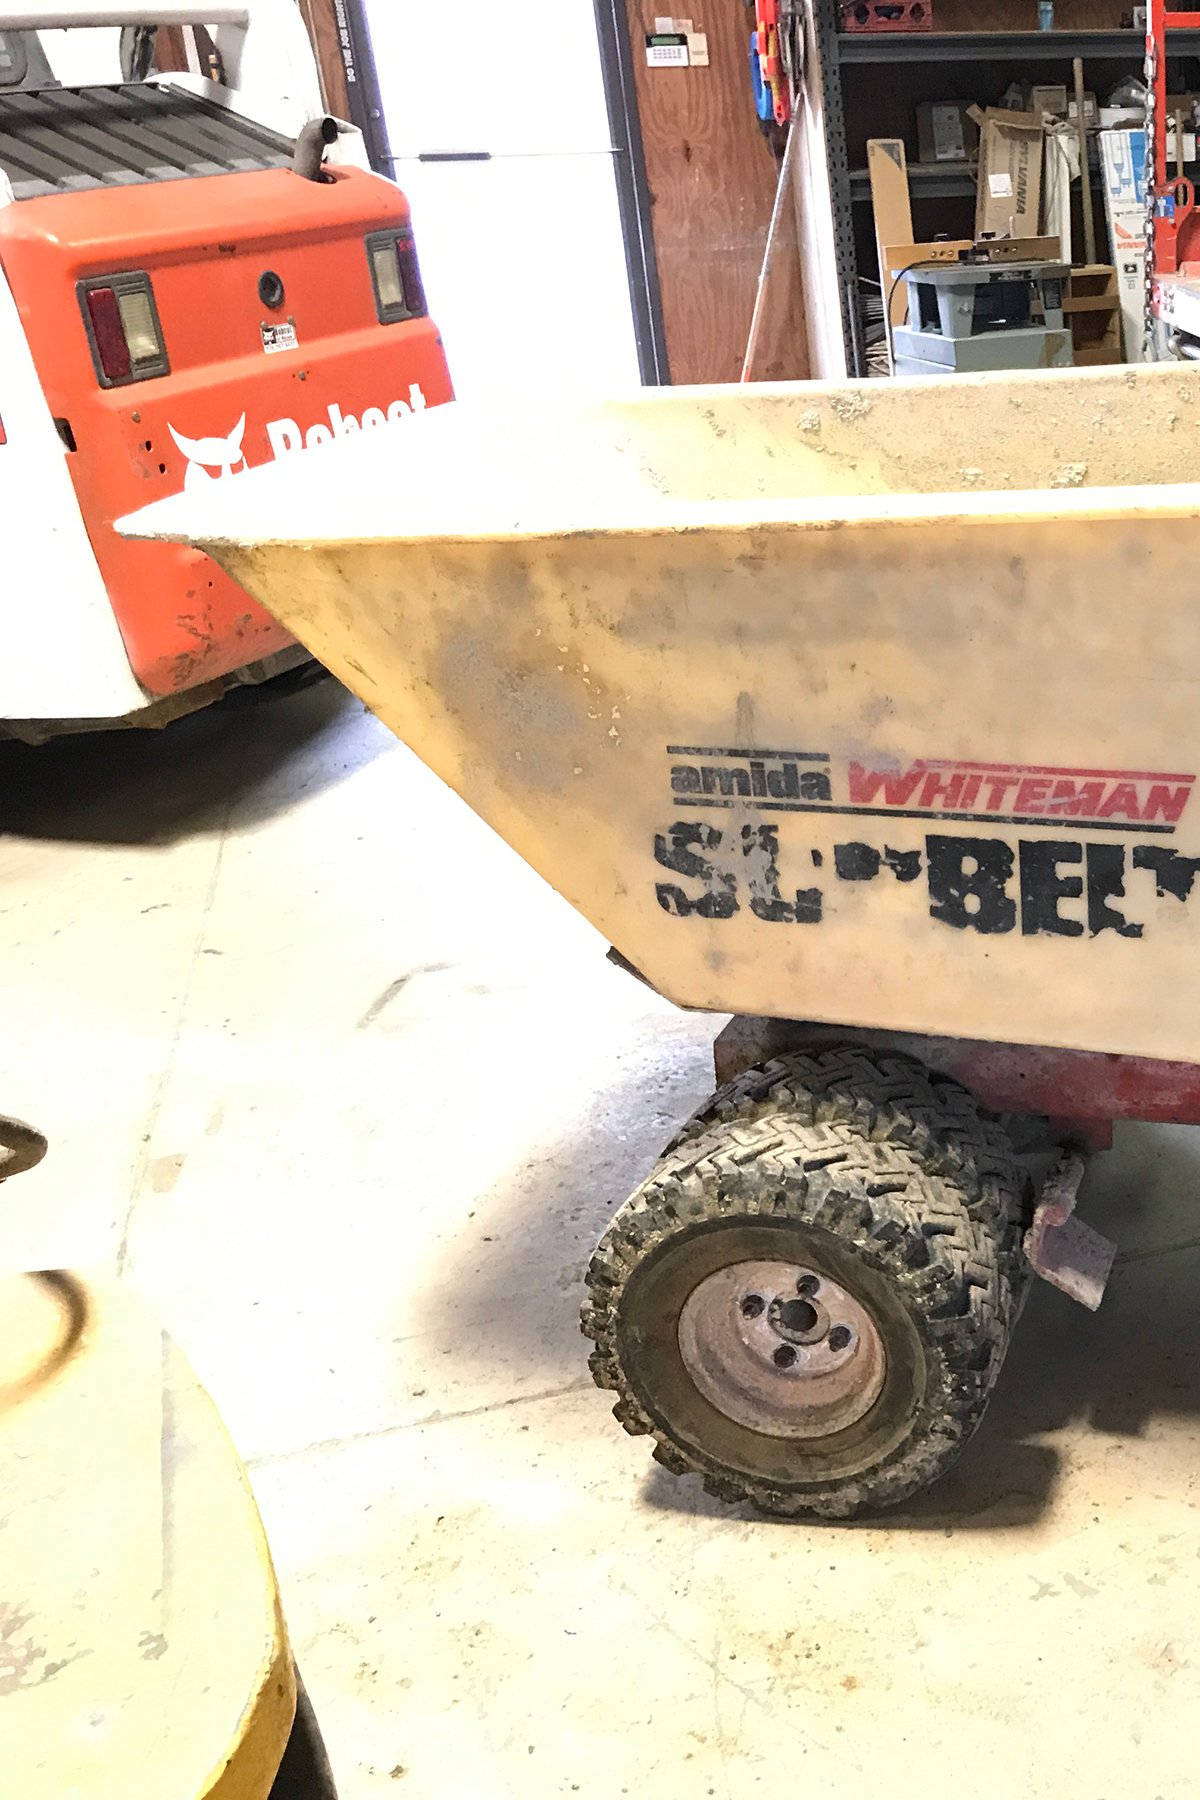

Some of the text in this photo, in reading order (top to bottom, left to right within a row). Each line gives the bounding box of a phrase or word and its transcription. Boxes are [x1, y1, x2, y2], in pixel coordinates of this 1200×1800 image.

[1016, 141, 1030, 215] SYLVANIA
[670, 759, 1192, 823] amida WHITEMAN
